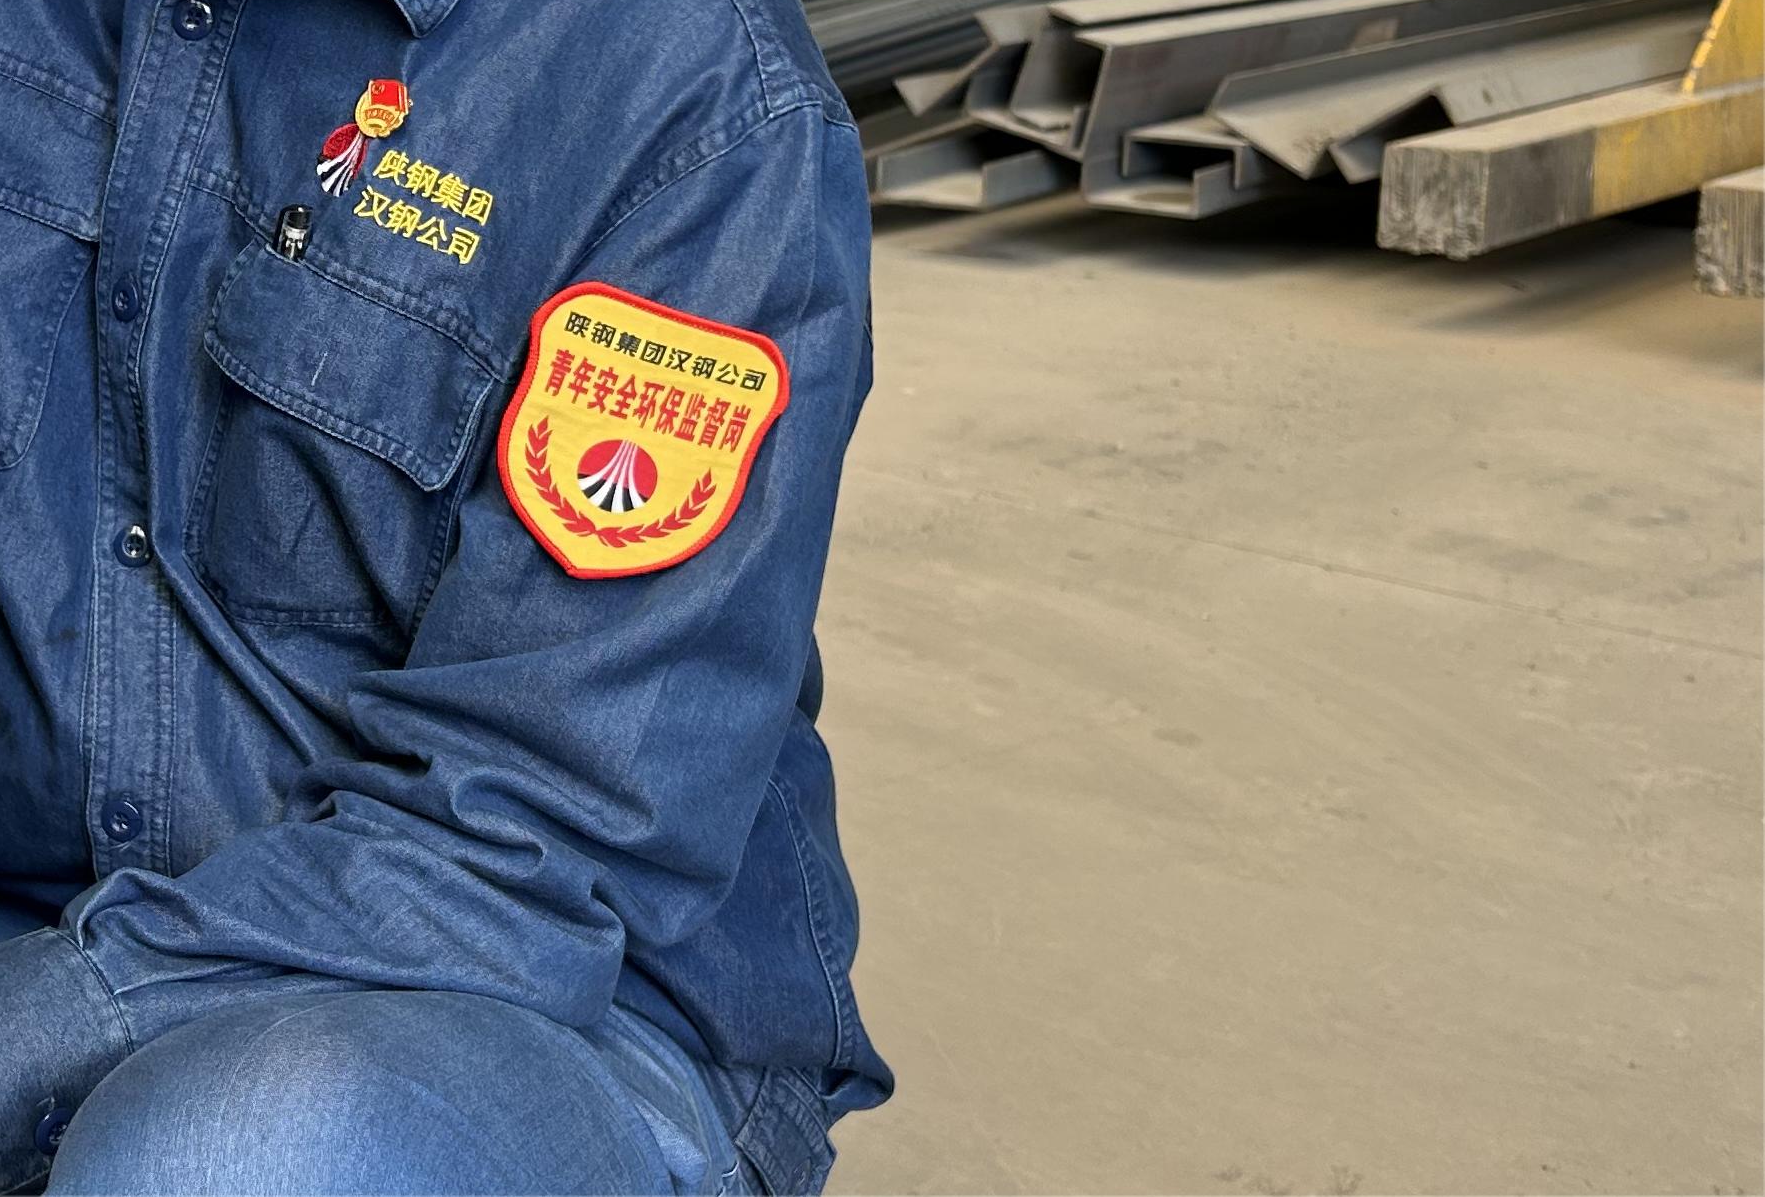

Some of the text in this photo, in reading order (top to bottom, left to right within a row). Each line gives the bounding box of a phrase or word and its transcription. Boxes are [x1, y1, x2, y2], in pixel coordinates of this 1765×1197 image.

[353, 185, 481, 265] 汉钢公司
[373, 149, 494, 227] 陕钢集团
[563, 311, 768, 392] 陕钢集团汉钢公司
[544, 348, 752, 453] 青年安全环保监督岗
